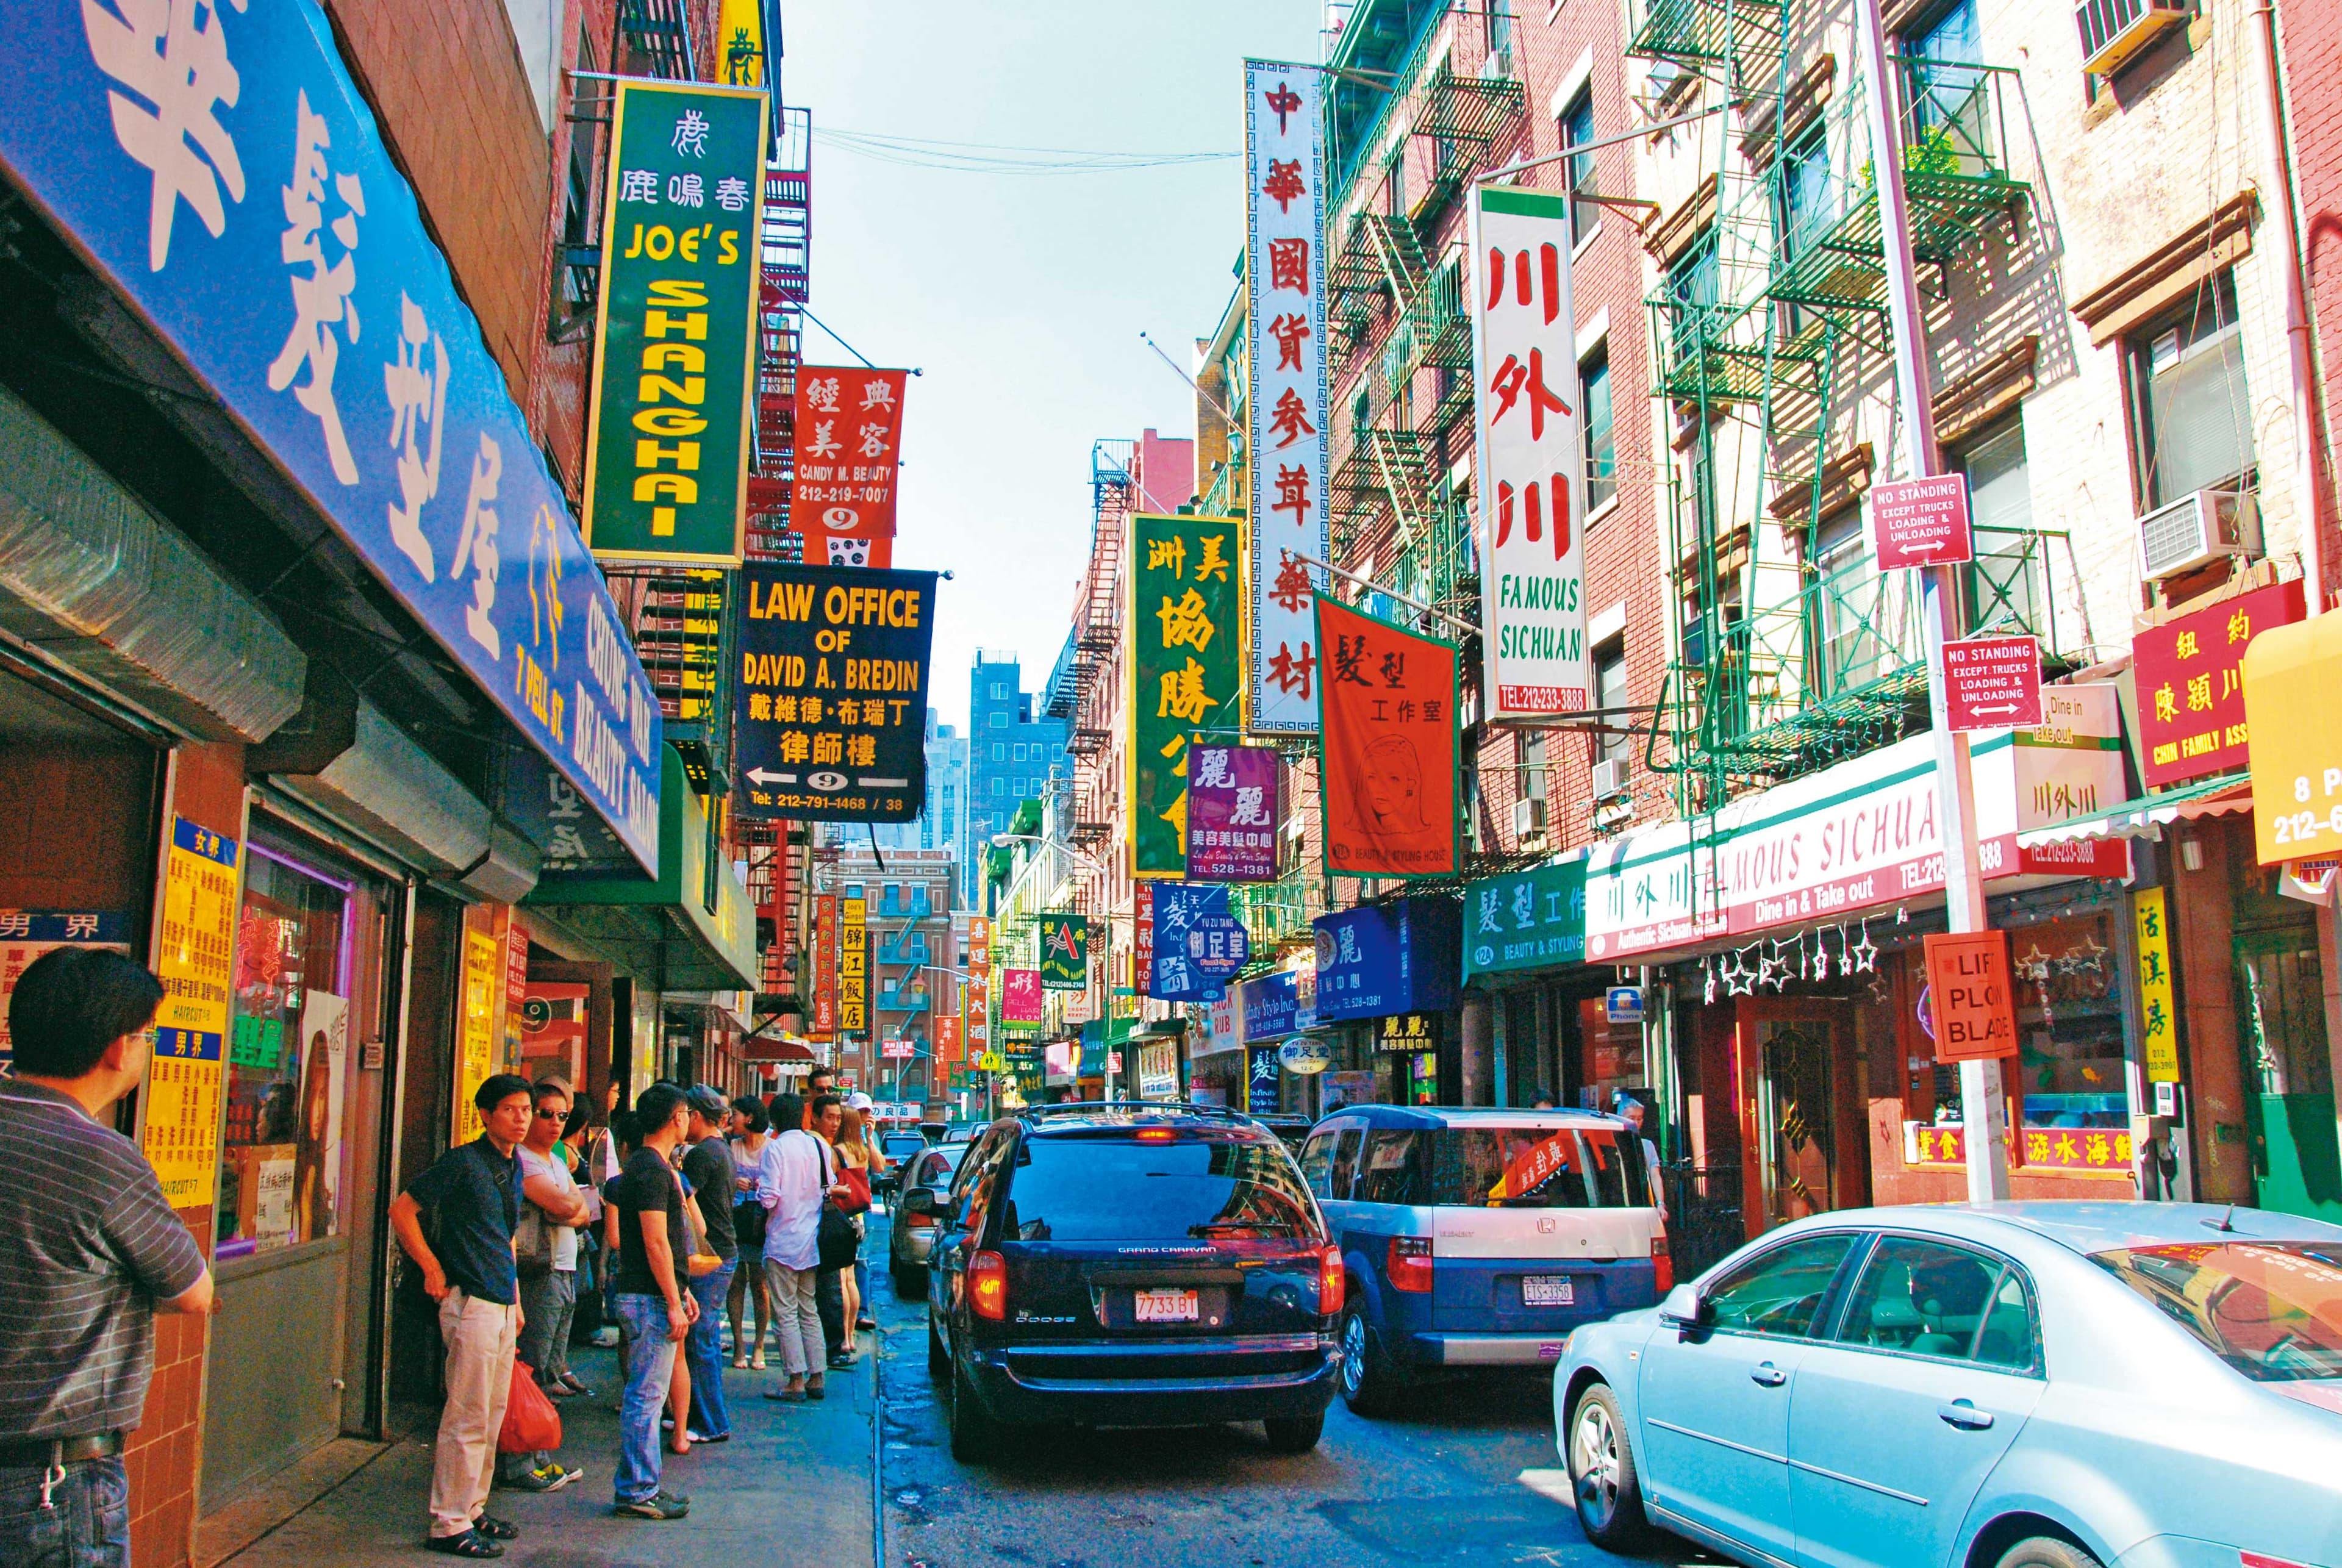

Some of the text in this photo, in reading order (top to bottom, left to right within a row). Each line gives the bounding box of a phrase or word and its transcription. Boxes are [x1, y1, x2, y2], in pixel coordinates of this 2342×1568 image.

[620, 170, 749, 212] 鹿鳴春
[625, 224, 738, 265] JOE'S
[806, 378, 895, 412] 經典
[1486, 242, 1572, 562] 川外川
[632, 280, 709, 537] SHANGHAI
[805, 420, 890, 459] 美容
[800, 464, 891, 481] CANDY M. BEAUTY
[800, 485, 889, 503] 212-219-7007
[1877, 484, 1957, 505] NO STANDING
[1882, 501, 1954, 518] EXCEPT TRUCKS
[1889, 514, 1949, 530] LOADING &
[1891, 526, 1951, 542] UNLOADING
[749, 581, 920, 627] LAW OFFICE
[1501, 575, 1578, 612] FAMOUS
[815, 629, 851, 653] OF
[1500, 625, 1580, 662] SICHUAN
[2176, 608, 2250, 659] 紐約
[1948, 645, 2030, 663] NO STANDING
[743, 653, 919, 691] DAVID A. BREDIN
[1953, 663, 2028, 678] EXCEPT TRUCKS
[1960, 676, 2022, 690] LOADING &
[525, 654, 548, 728] PELL
[1502, 686, 1584, 711] TEL:212-233-3888
[1961, 689, 2024, 702] UNLOADING
[1370, 700, 1441, 723] 工作室
[2046, 711, 2051, 724] &
[2050, 696, 2082, 716] Dine in
[2057, 726, 2072, 742] out
[779, 730, 876, 767] 律師樓
[2154, 742, 2179, 766] CHIN
[2182, 730, 2219, 758] FAMILY
[573, 680, 659, 855] BEAUTY SALON
[2294, 767, 2342, 803] 8 P
[751, 790, 771, 805] Tel:
[778, 794, 865, 811] 212-791-1468
[886, 799, 903, 811] 38
[2034, 781, 2097, 818] 川外川
[1192, 830, 1272, 848] 美容美髮中心
[1211, 864, 1270, 875] 528-1381
[1607, 861, 1688, 922] 川外川
[1755, 875, 1874, 923] Dine in & Take out
[1201, 918, 1234, 928] YU ZU TANG
[1191, 931, 1244, 958] 御足堂
[1504, 941, 1533, 960] BEAUTY
[1538, 940, 1545, 955] &
[1548, 934, 1584, 955] STYLING
[1617, 928, 1656, 951] Authentic
[1658, 921, 1692, 943] Sichuan
[845, 928, 863, 1026] 錦江飯店
[1214, 1015, 1230, 1035] RUB
[1949, 1017, 2010, 1043] BLADE
[1283, 1046, 1330, 1059] 御足堂
[1250, 1089, 1276, 1097] Infinity
[1138, 1297, 1174, 1314] 7733
